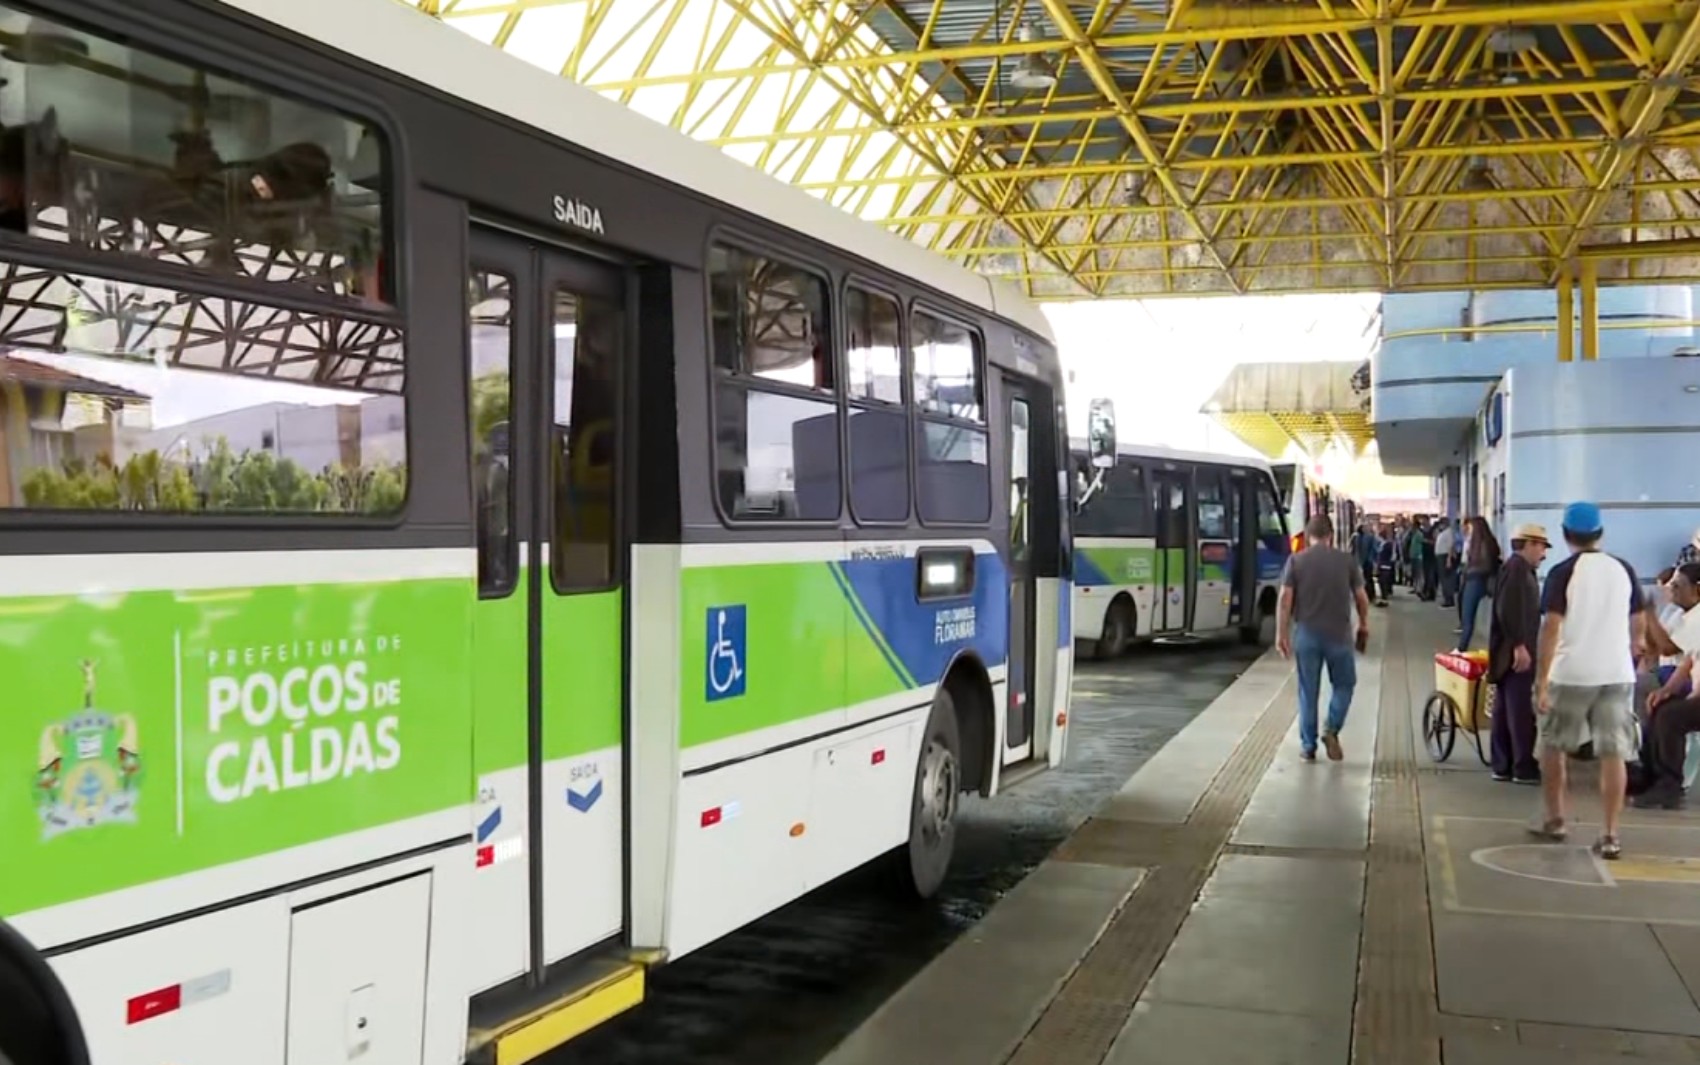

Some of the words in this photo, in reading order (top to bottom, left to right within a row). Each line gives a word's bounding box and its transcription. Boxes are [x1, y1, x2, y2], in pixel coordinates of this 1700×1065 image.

[553, 195, 605, 236] SAÍDA
[208, 638, 366, 668] PREFEITURA
[376, 634, 401, 652] DE
[207, 660, 369, 733] POÇOS
[373, 679, 401, 708] DE
[206, 716, 402, 803] CALDAS
